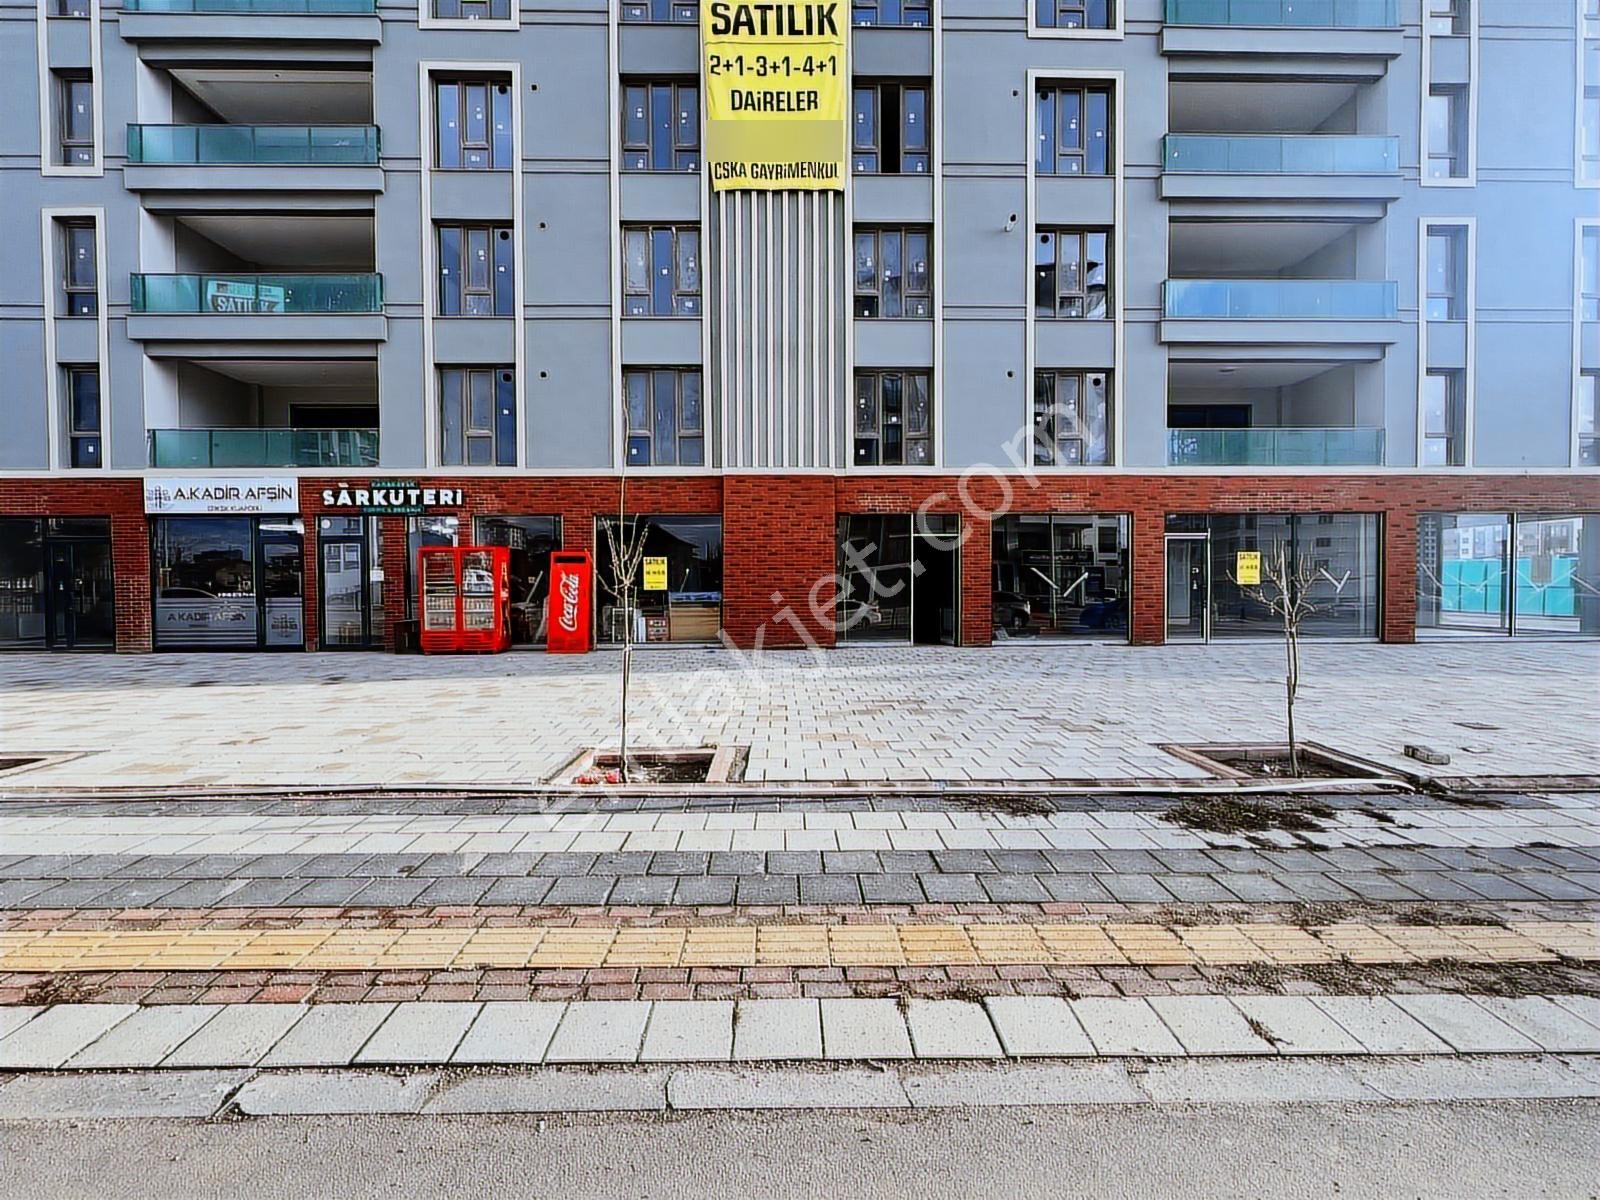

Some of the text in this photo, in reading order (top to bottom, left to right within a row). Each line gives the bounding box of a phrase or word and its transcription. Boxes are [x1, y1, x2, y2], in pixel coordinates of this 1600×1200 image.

[711, 3, 838, 36] SATILIK
[710, 55, 837, 77] 2+1-3+1-4+1
[714, 162, 747, 180] CSKA
[174, 484, 292, 502] A.KADİR AFŞİN
